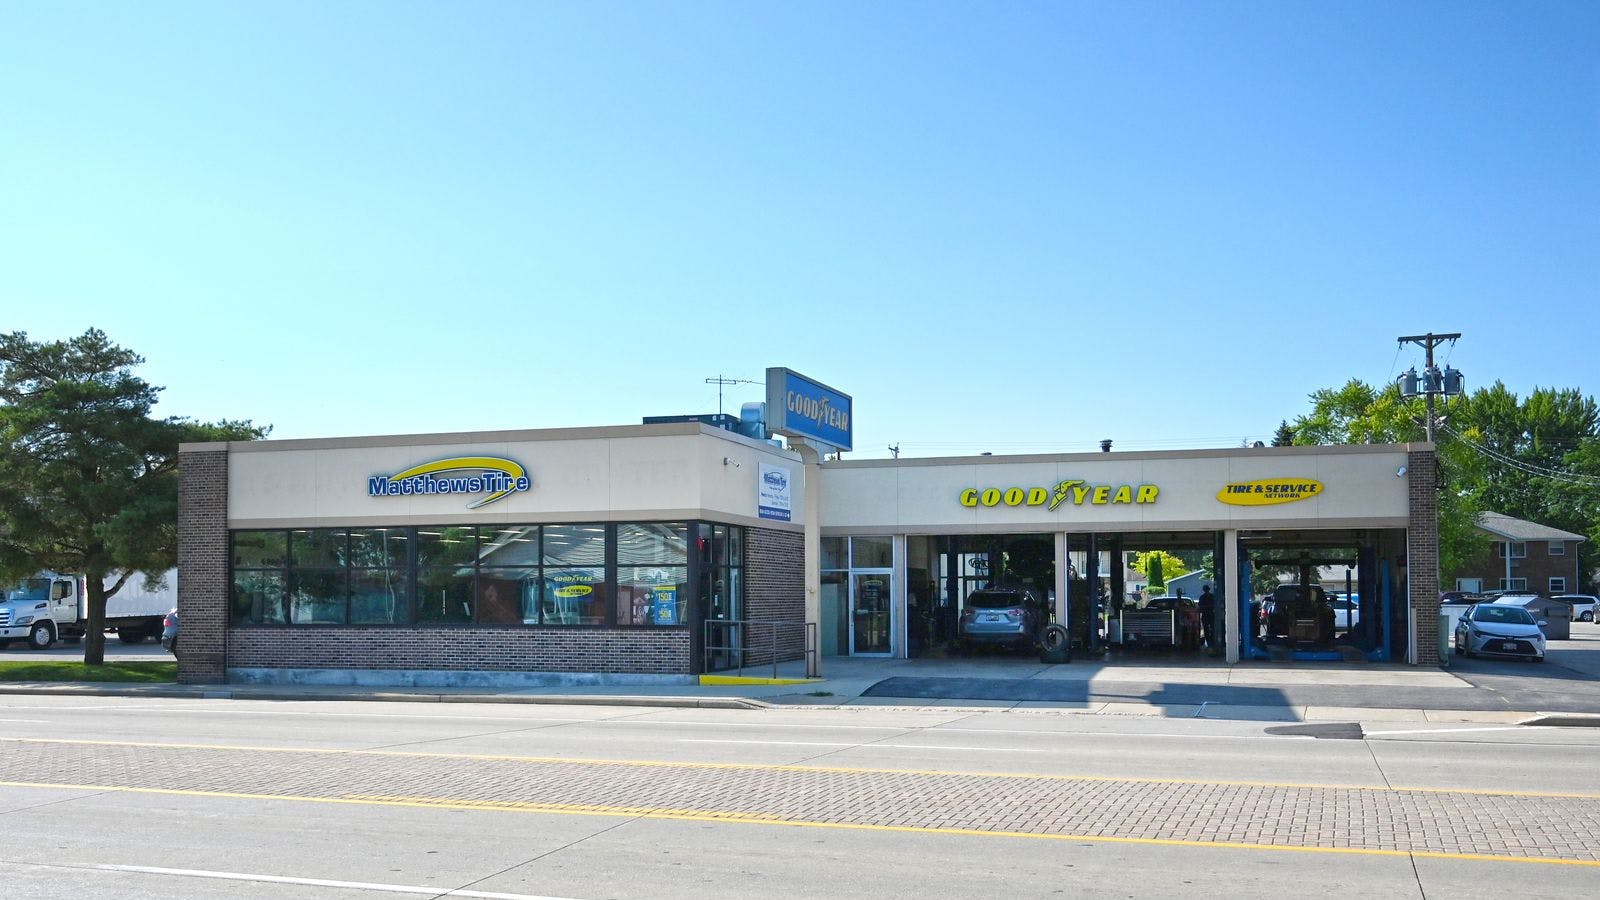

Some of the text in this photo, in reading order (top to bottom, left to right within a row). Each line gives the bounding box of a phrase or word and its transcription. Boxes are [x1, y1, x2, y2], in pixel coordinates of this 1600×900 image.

[1227, 483, 1317, 493] TIRE & SERVICE
